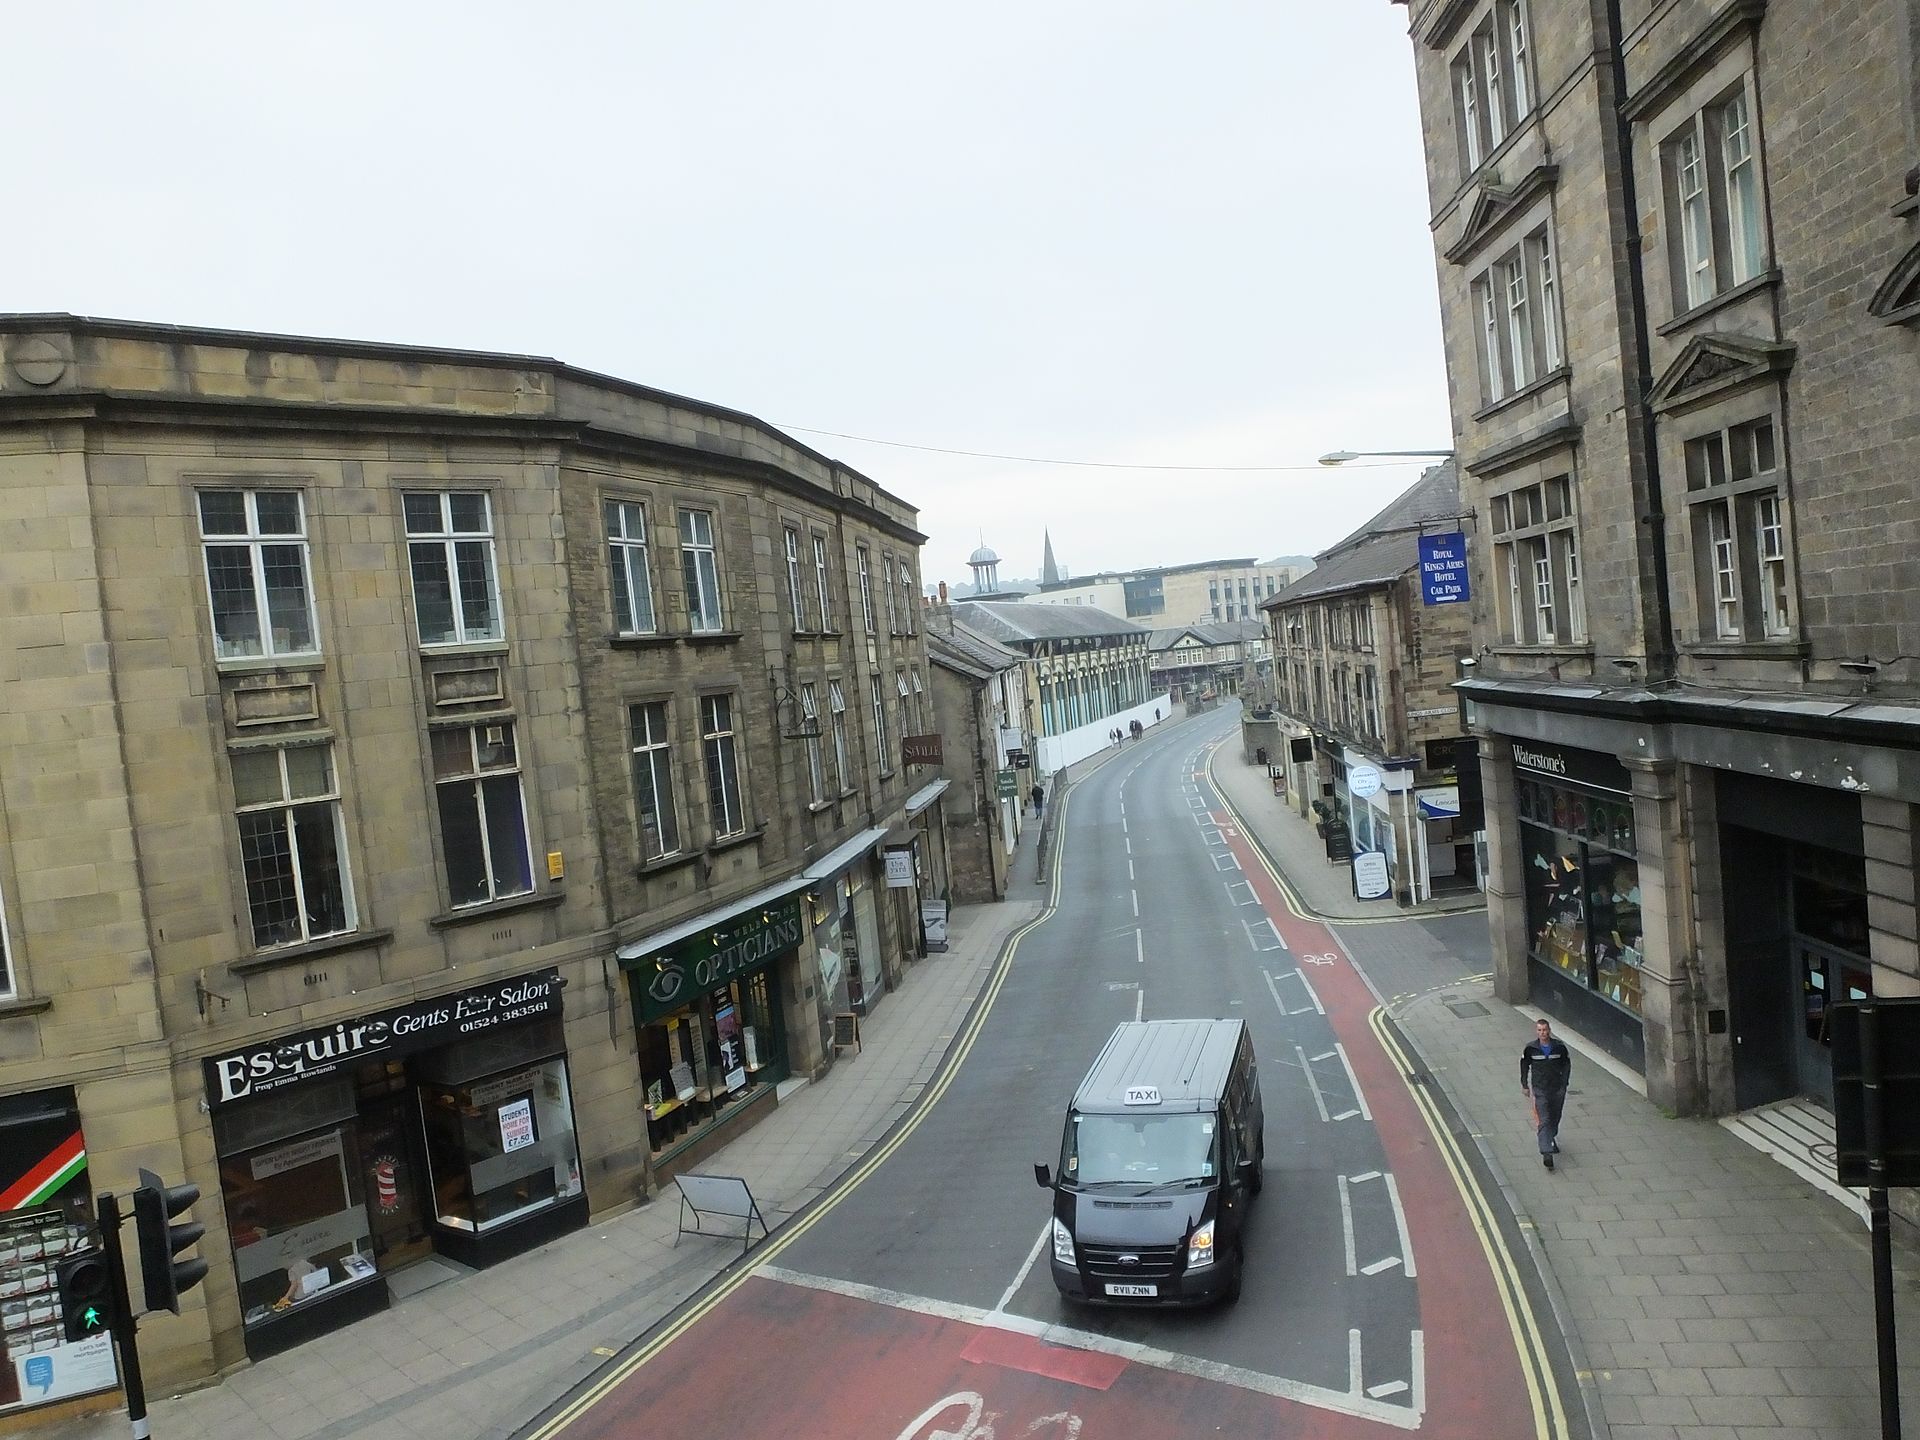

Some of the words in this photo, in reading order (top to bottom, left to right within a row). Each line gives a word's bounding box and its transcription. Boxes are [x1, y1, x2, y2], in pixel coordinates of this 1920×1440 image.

[1433, 550, 1454, 560] ROYAL
[1424, 562, 1445, 572] KINGS
[1446, 560, 1465, 570] ARMS
[1434, 572, 1456, 582] HOTEL
[1430, 586, 1444, 596] CAR
[1445, 584, 1462, 594] PARK
[1512, 744, 1566, 774] Waterstone's
[695, 918, 798, 986] OPTICIANS
[460, 1015, 499, 1033] 01524
[502, 1001, 548, 1022] 383561
[216, 1022, 390, 1103] Esquire
[392, 1009, 450, 1036] Gents
[454, 994, 496, 1020] Hr
[500, 981, 550, 1007] Salon
[301, 1064, 337, 1079] Rowlands
[1128, 1091, 1157, 1100] TAXI
[501, 1107, 529, 1122] STUDENTS
[508, 1134, 530, 1147] £7.50
[1132, 1286, 1150, 1295] ZNN
